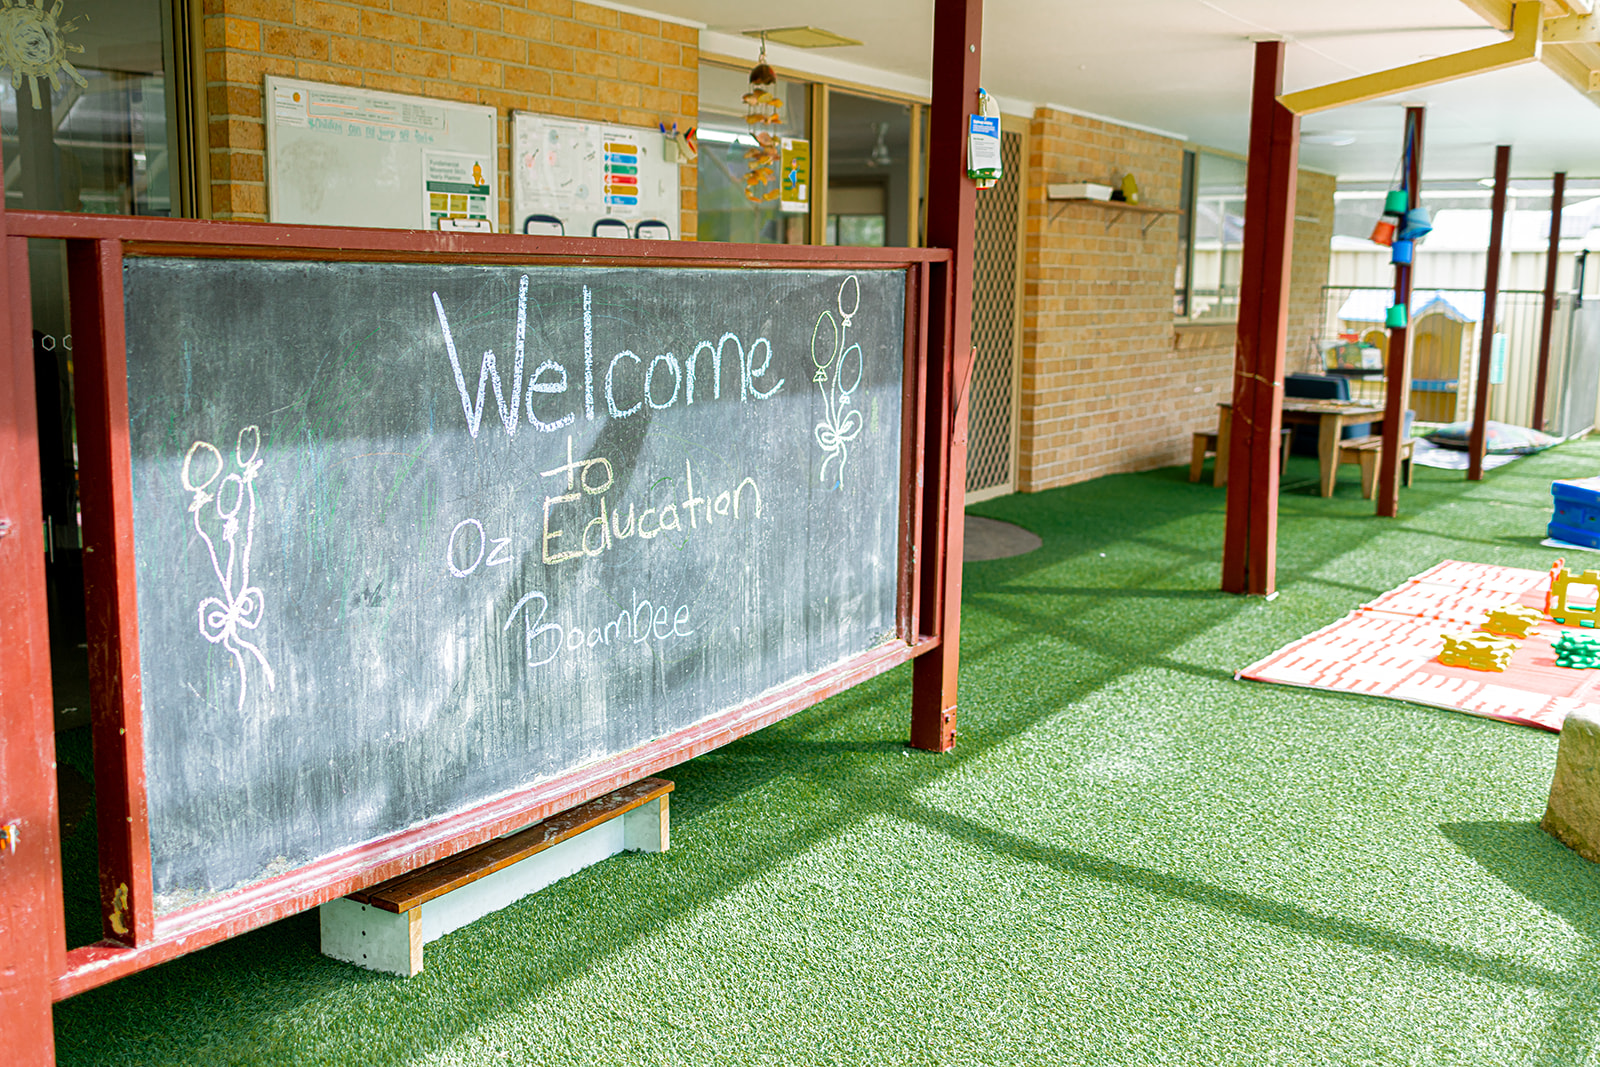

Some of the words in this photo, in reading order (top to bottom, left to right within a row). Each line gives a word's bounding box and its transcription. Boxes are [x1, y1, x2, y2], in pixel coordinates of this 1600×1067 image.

[432, 274, 784, 438] Welcome
[540, 435, 614, 494] to
[446, 518, 515, 578] Oz
[541, 458, 762, 565] Education
[504, 587, 694, 667] Boambee
